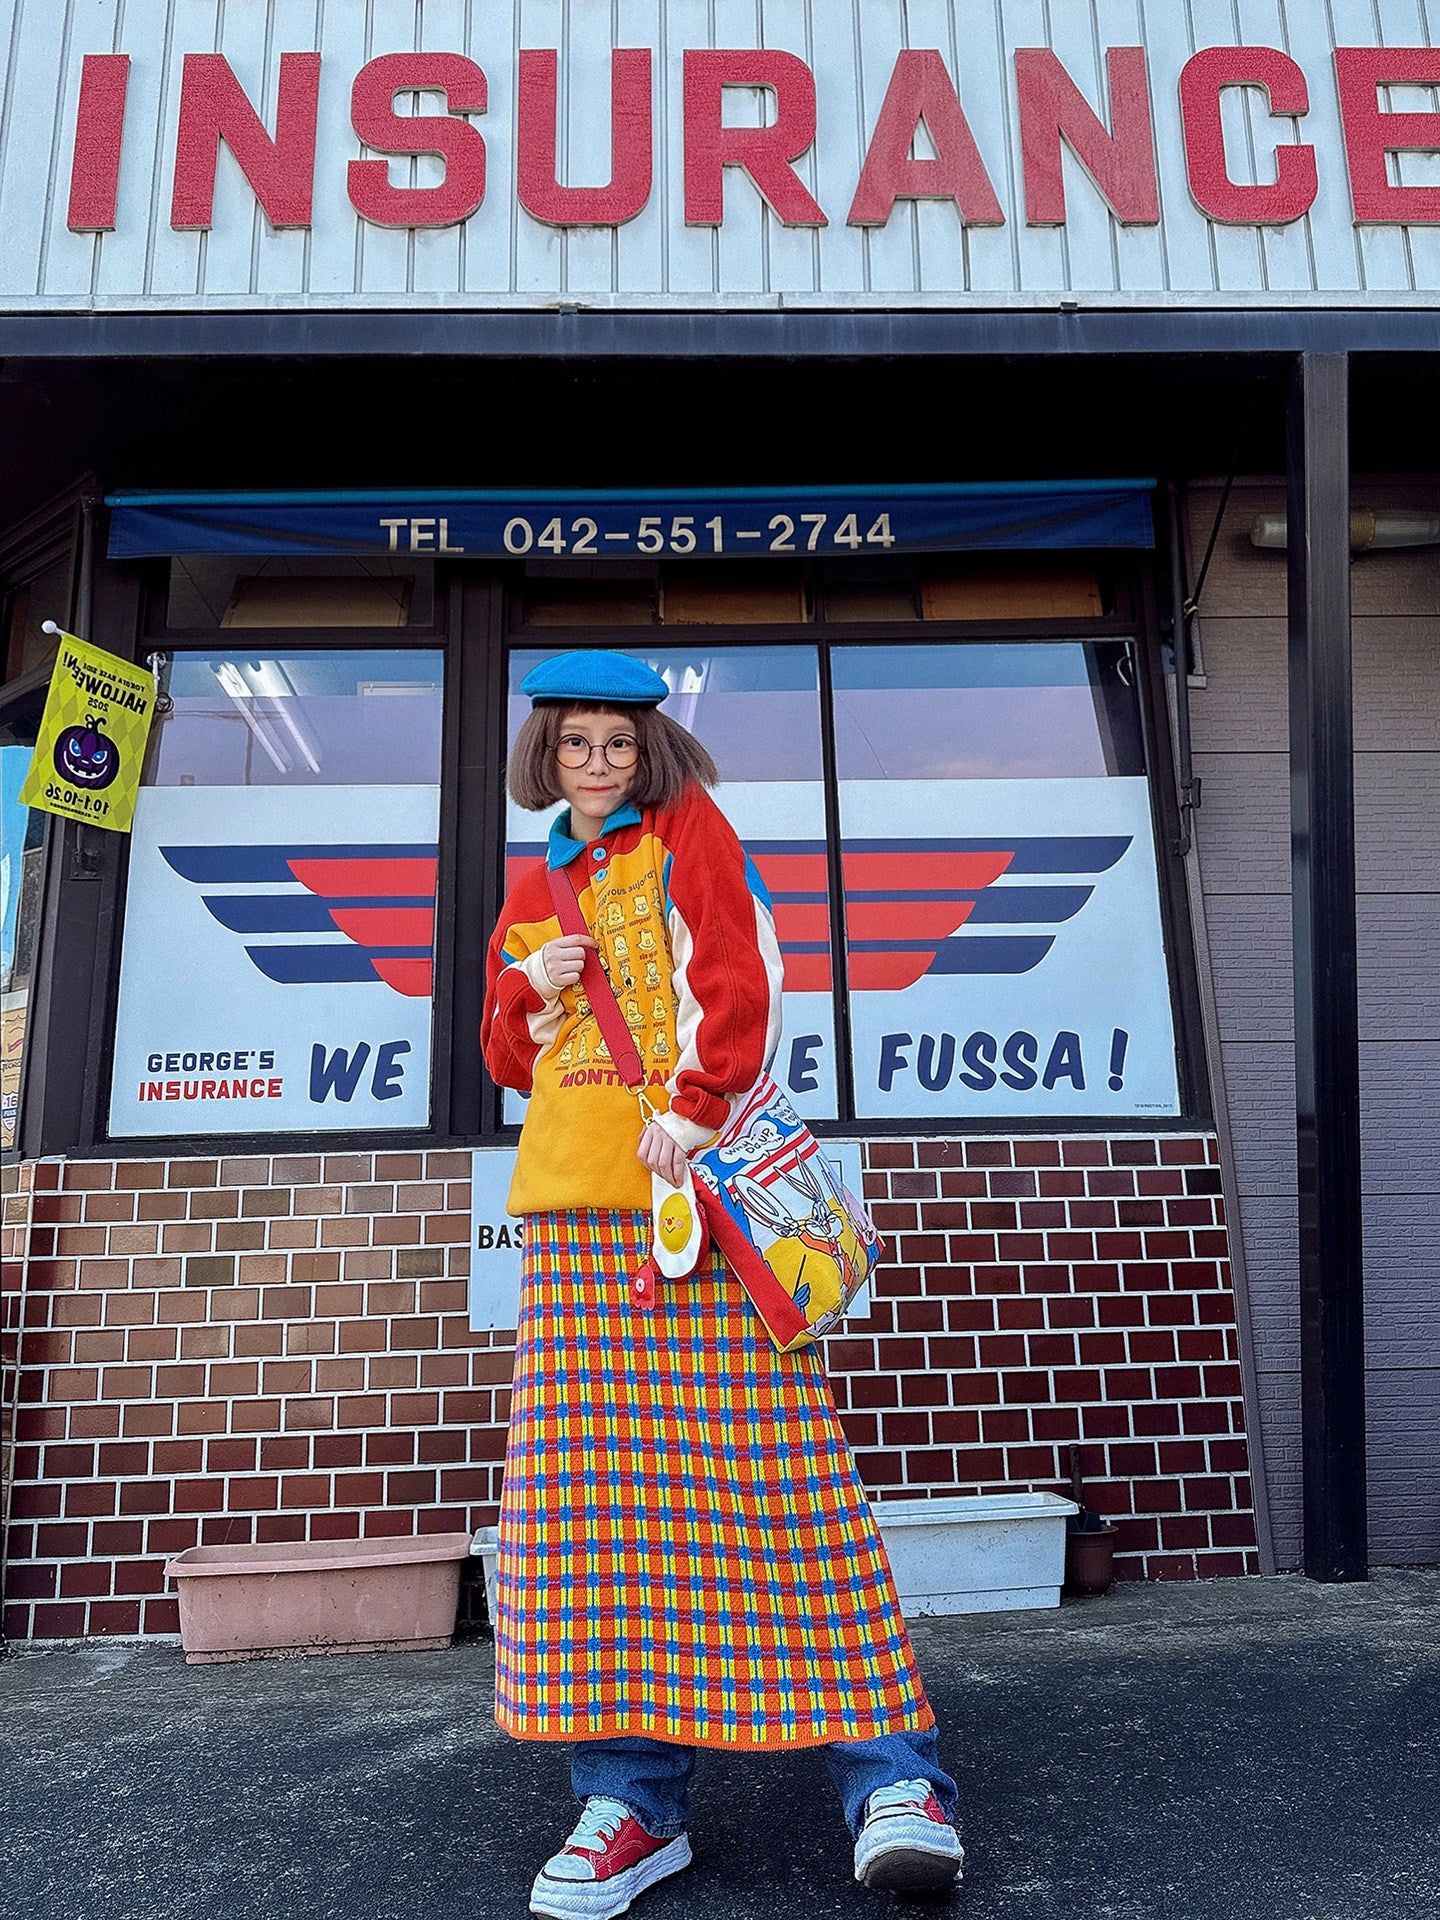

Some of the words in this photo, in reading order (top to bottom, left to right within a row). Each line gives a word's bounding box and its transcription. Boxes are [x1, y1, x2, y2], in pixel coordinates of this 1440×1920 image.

[67, 46, 1440, 232] INSURANCE
[379, 518, 463, 552] TEL
[503, 513, 896, 555] 042-551-2744
[147, 1050, 275, 1072] GEORGE'S
[309, 1040, 411, 1103] WE
[878, 1030, 1086, 1092] FUSSA
[138, 1078, 283, 1102] INSURANCE
